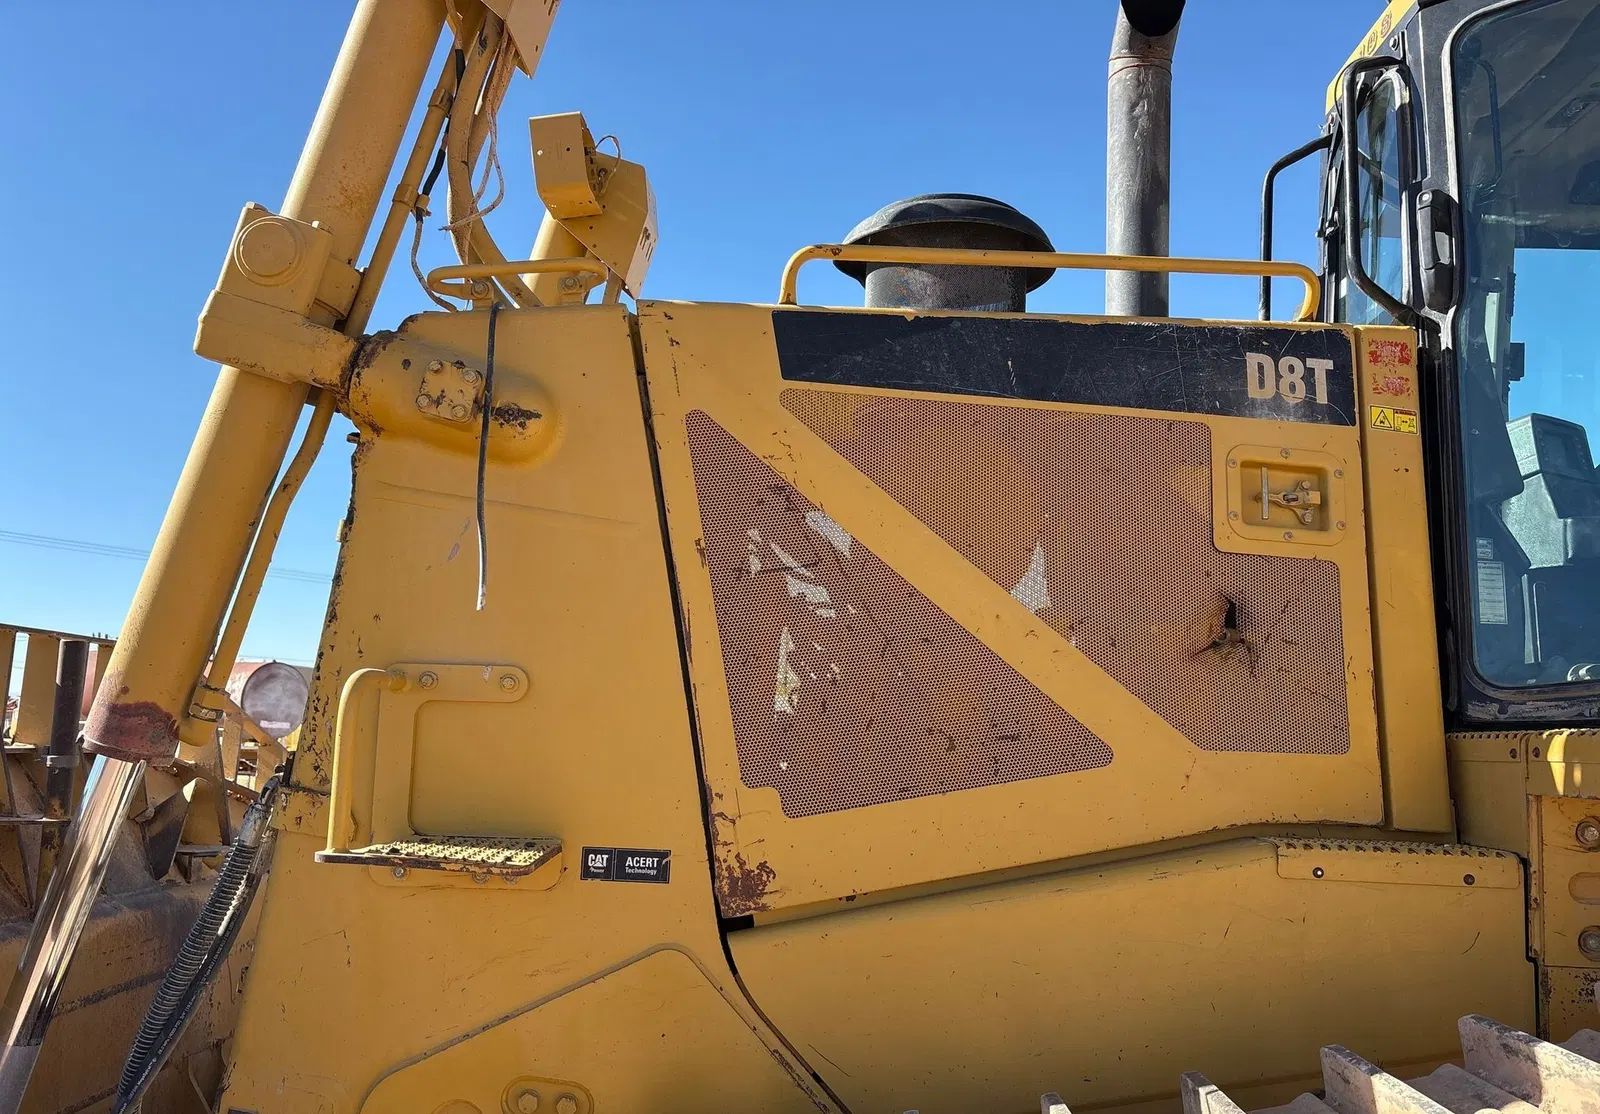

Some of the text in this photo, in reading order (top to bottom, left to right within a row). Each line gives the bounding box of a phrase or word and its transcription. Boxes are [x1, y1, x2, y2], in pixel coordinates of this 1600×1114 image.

[1246, 352, 1334, 404] D8T
[588, 854, 609, 867] CAT
[625, 856, 659, 868] ACERT
[625, 867, 658, 875] Technology
